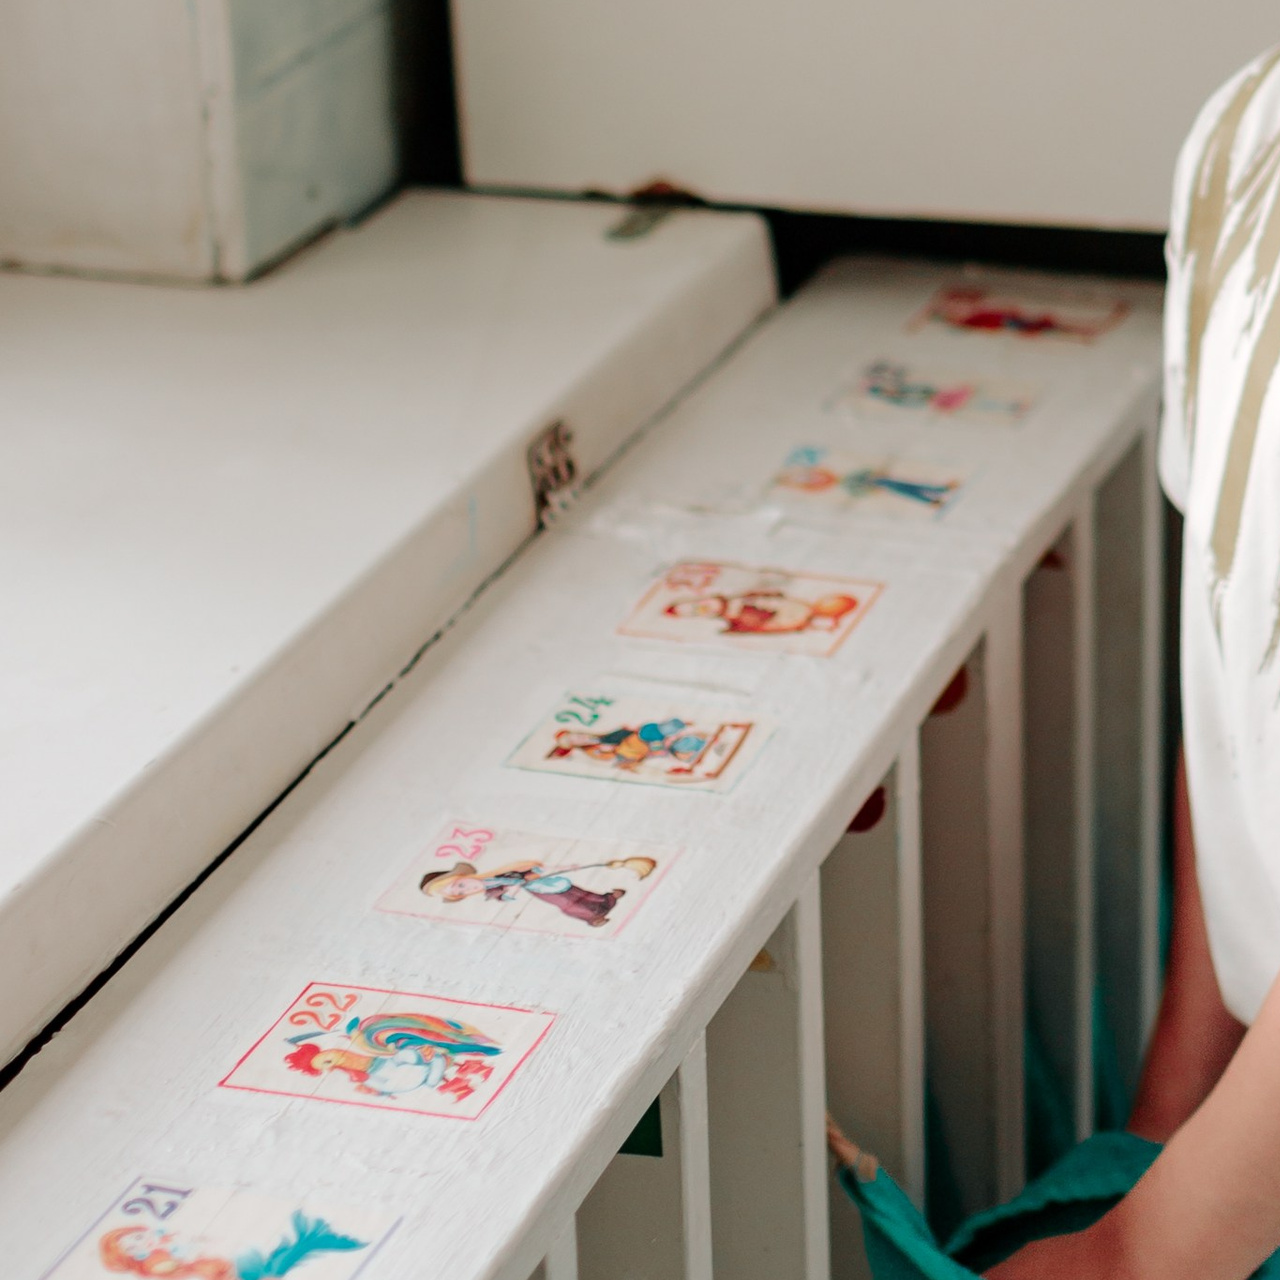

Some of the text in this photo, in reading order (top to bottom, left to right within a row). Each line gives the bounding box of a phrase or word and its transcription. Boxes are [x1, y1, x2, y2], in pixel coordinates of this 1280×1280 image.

[555, 695, 614, 728] 24
[435, 827, 495, 860] 23
[289, 992, 357, 1031] 22
[121, 1184, 193, 1221] 21
